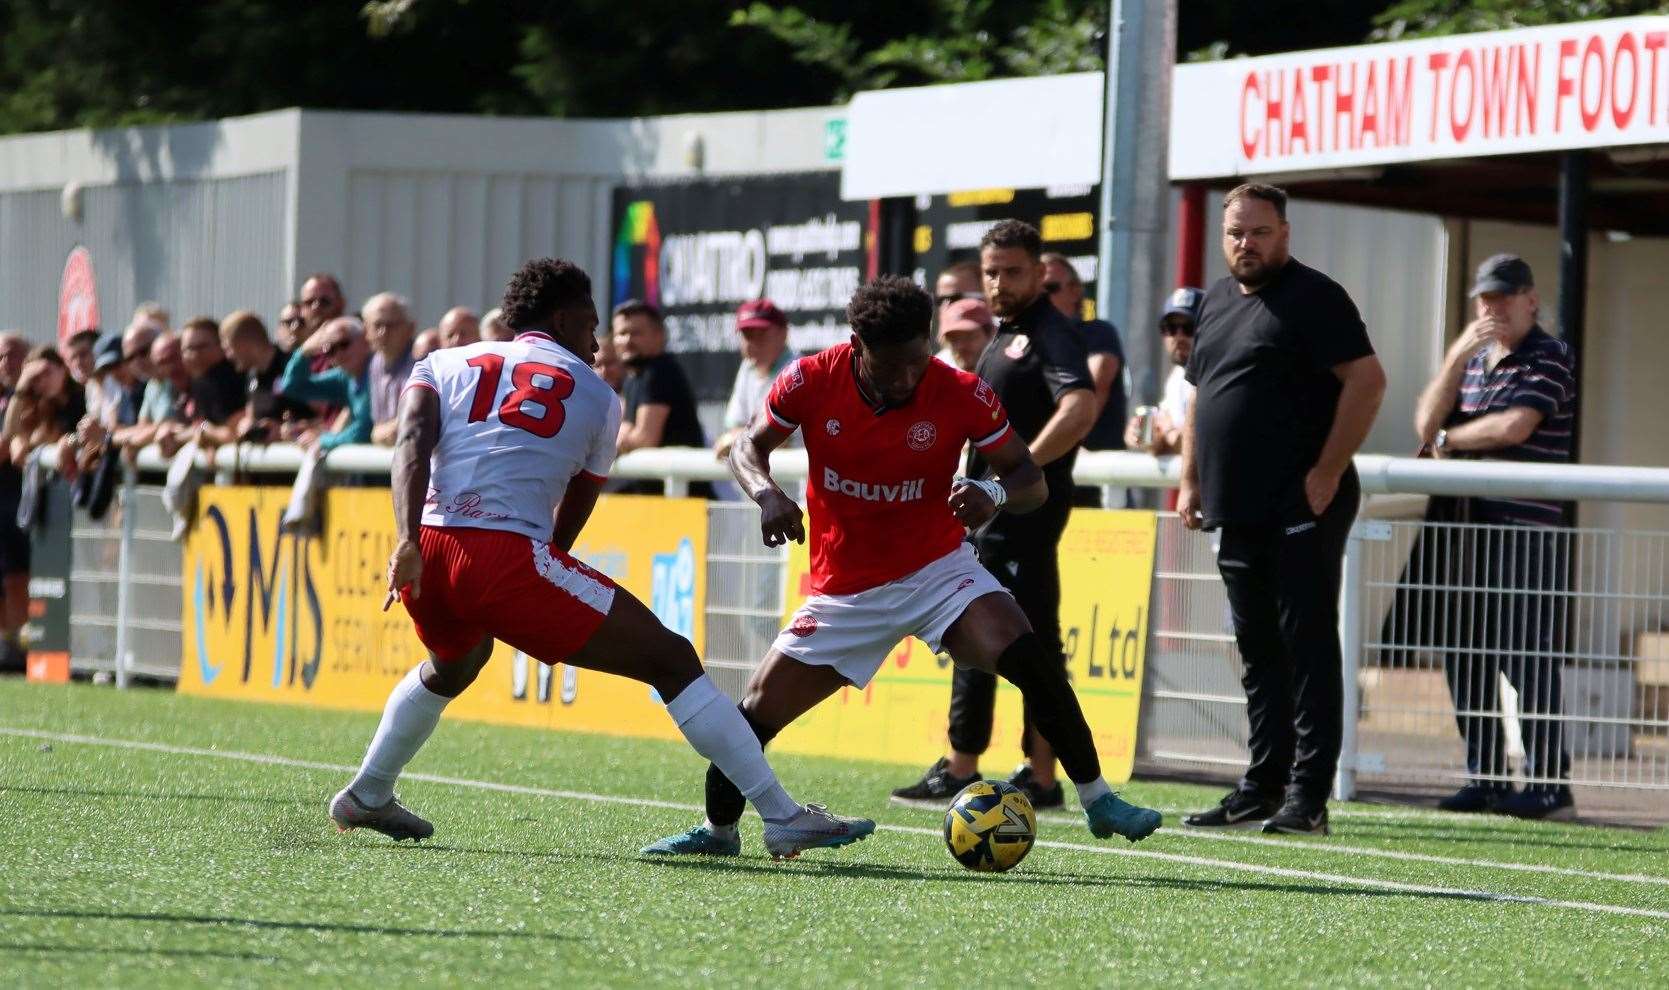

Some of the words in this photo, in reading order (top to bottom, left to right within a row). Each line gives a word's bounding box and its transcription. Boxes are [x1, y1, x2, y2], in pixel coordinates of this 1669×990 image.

[1240, 55, 1414, 161] CHATHAM
[1428, 42, 1541, 143] TOWN
[1553, 31, 1669, 134] FOOT
[466, 352, 576, 439] 18
[823, 466, 925, 502] Bauvill
[1088, 603, 1143, 680] Ltd
